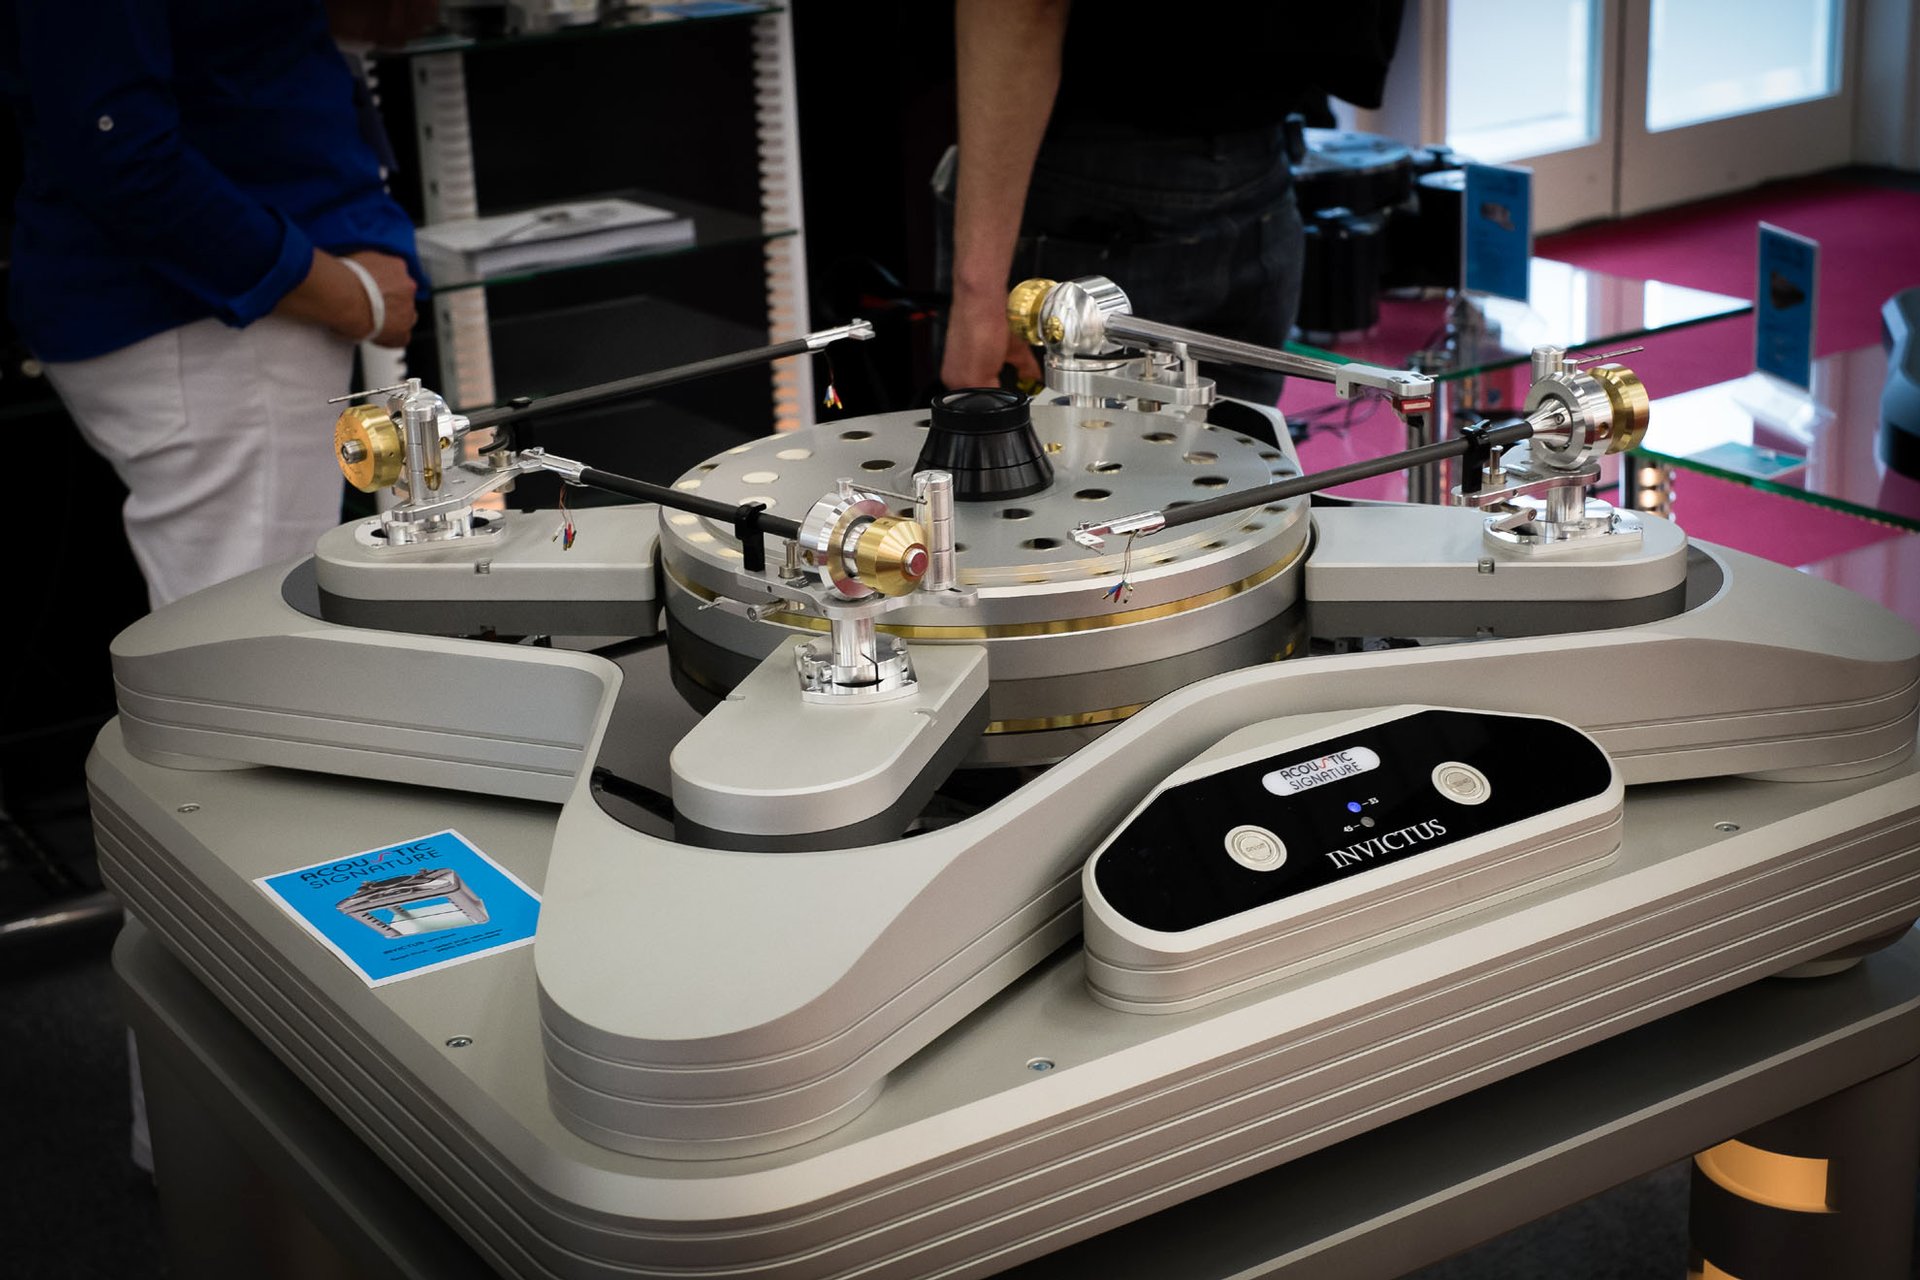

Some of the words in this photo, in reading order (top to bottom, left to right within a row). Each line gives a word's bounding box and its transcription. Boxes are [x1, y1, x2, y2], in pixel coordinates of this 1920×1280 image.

[1280, 752, 1353, 780] ACOUSTIC
[1289, 761, 1362, 790] SIGNATURE
[300, 842, 431, 881] ACOUSTIC
[1325, 818, 1447, 869] INVICTUS
[309, 849, 442, 889] SIGNATURE
